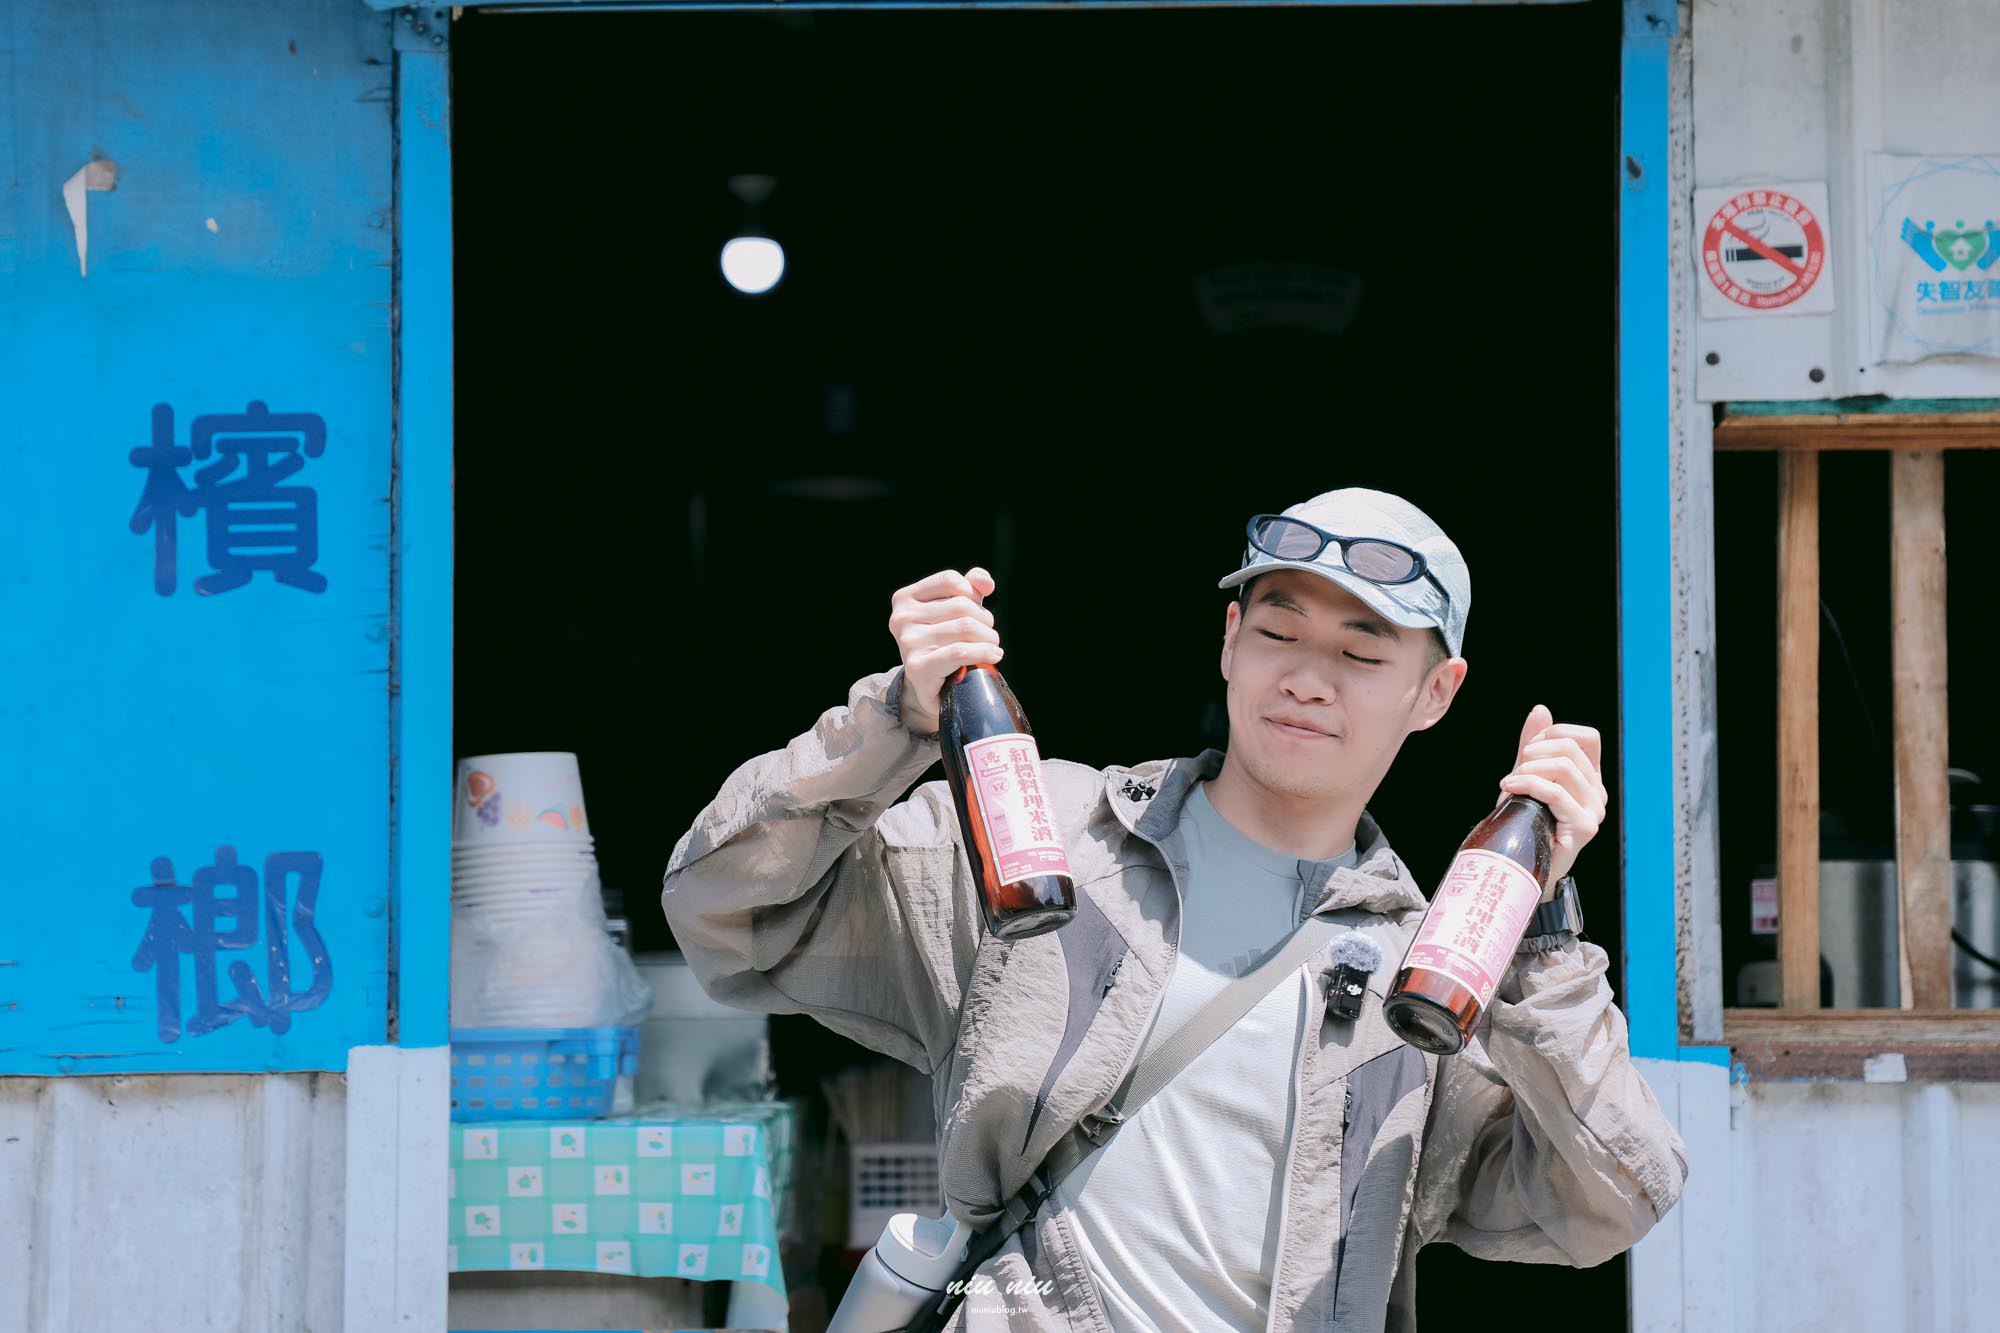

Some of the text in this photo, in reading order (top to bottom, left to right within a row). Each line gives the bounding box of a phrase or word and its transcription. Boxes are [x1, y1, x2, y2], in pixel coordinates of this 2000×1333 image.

[128, 400, 333, 1045] 檳榔
[1009, 747, 1054, 841] 紅標料理米酒
